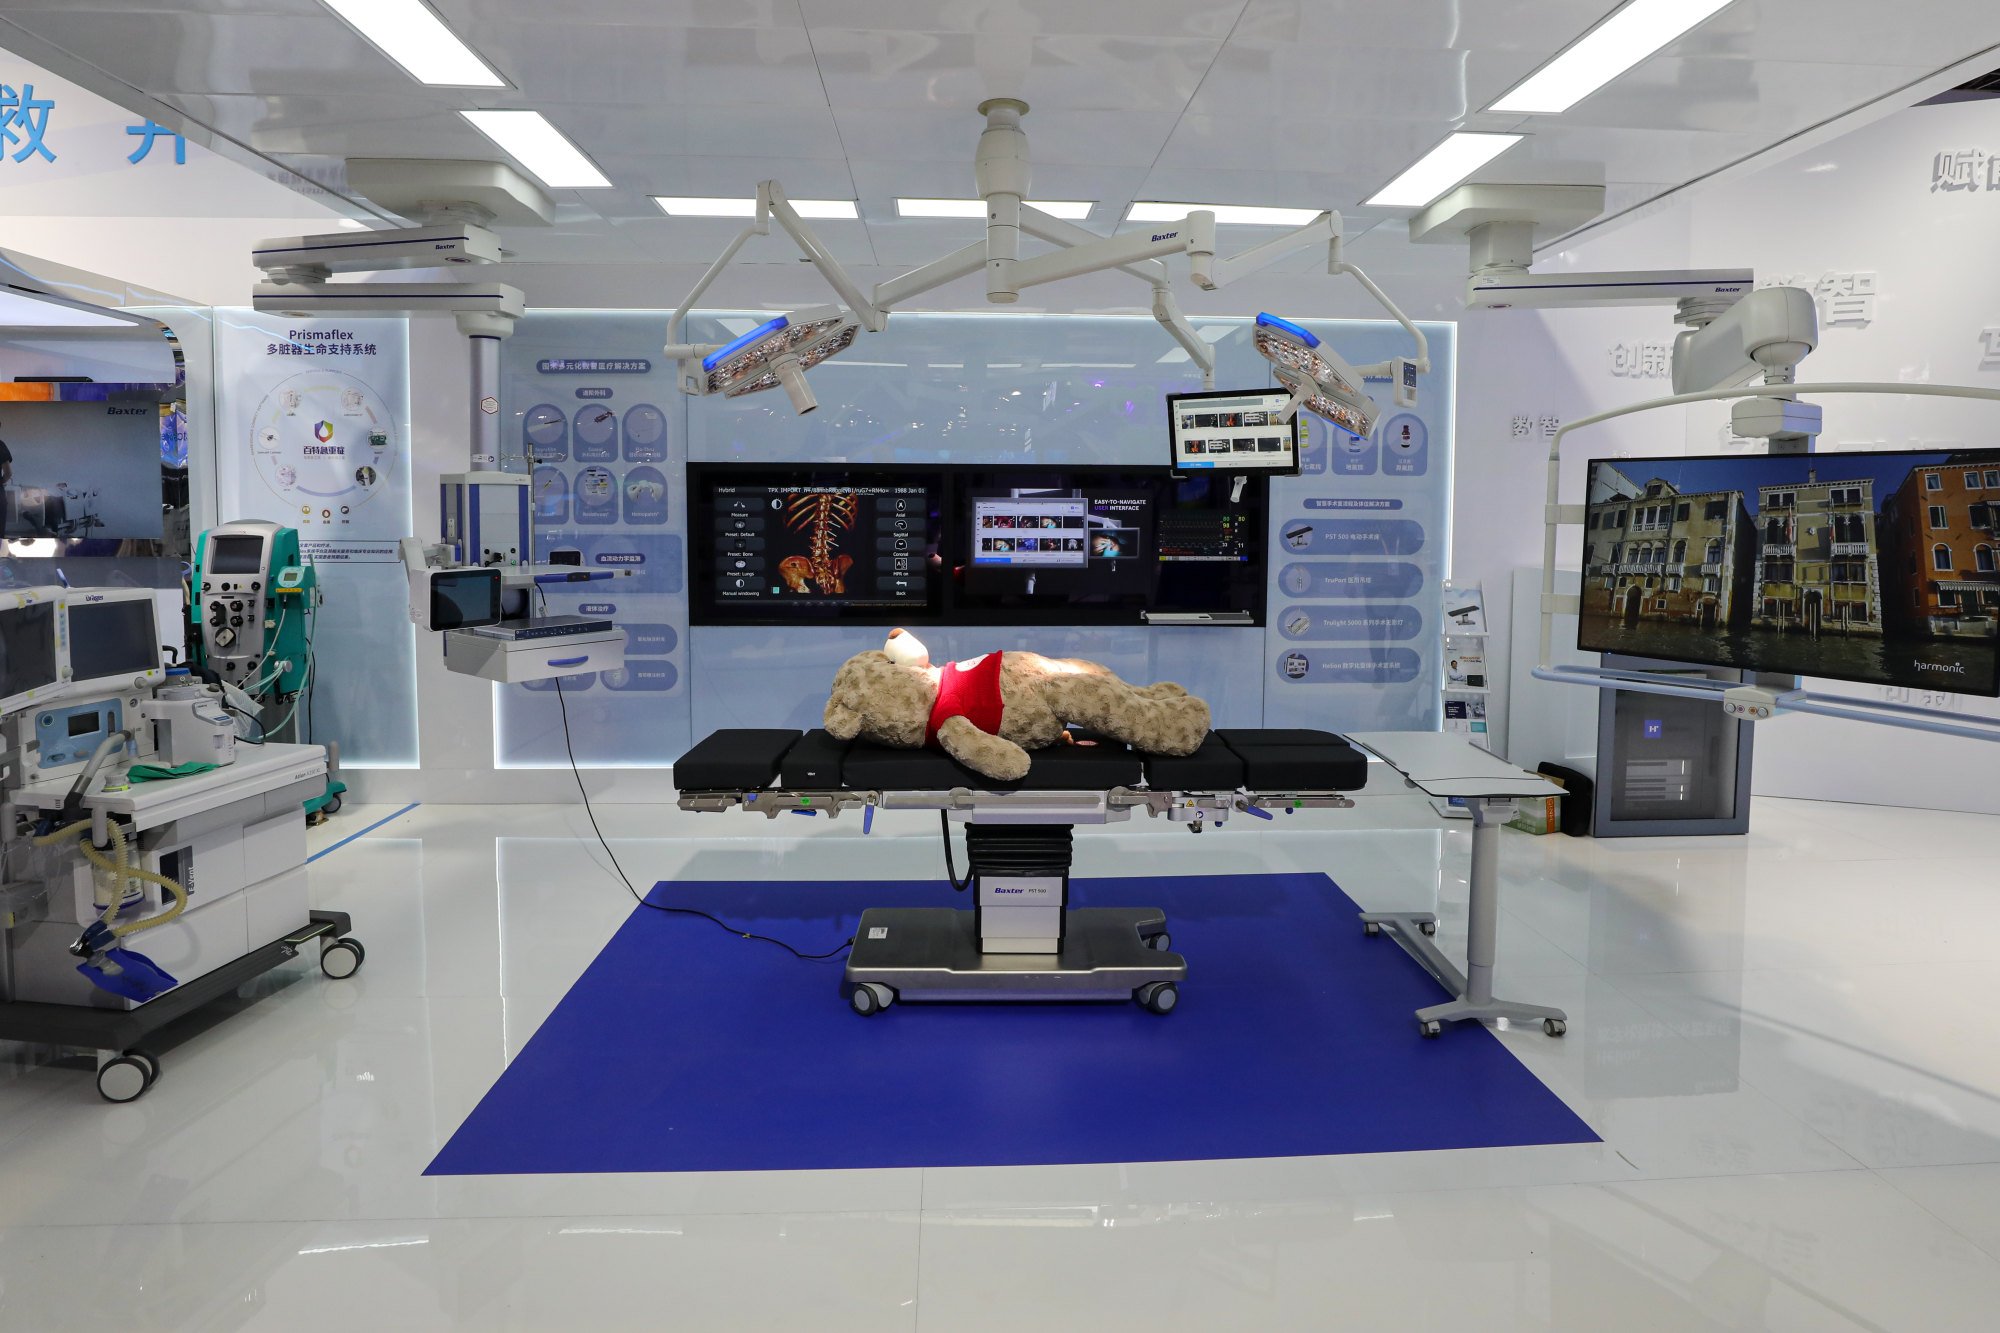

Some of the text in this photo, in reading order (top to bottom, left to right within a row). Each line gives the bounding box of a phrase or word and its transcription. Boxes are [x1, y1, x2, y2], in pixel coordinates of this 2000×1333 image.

[1152, 232, 1178, 242] Baxter
[289, 330, 354, 340] Prismaflex
[267, 343, 377, 356] 多脏器生命支持系统
[107, 406, 149, 415] Baxter
[1913, 660, 1964, 674] harmonic
